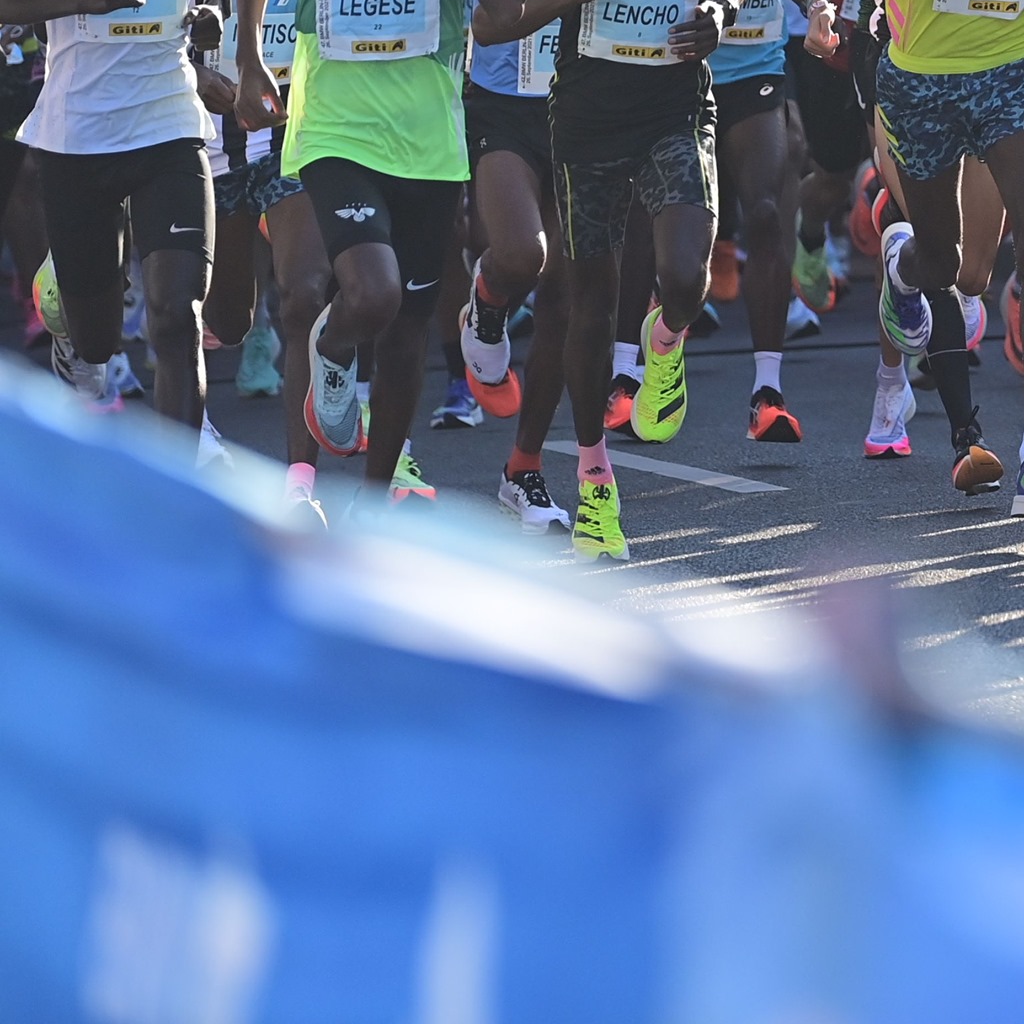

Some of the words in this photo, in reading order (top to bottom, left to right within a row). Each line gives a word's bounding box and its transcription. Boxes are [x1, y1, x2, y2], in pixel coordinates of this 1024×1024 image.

[971, 2, 1001, 11] Giti
[602, 2, 679, 26] LENCHO
[112, 25, 144, 35] Giti
[355, 42, 387, 52] Giti
[615, 47, 646, 57] Giti
